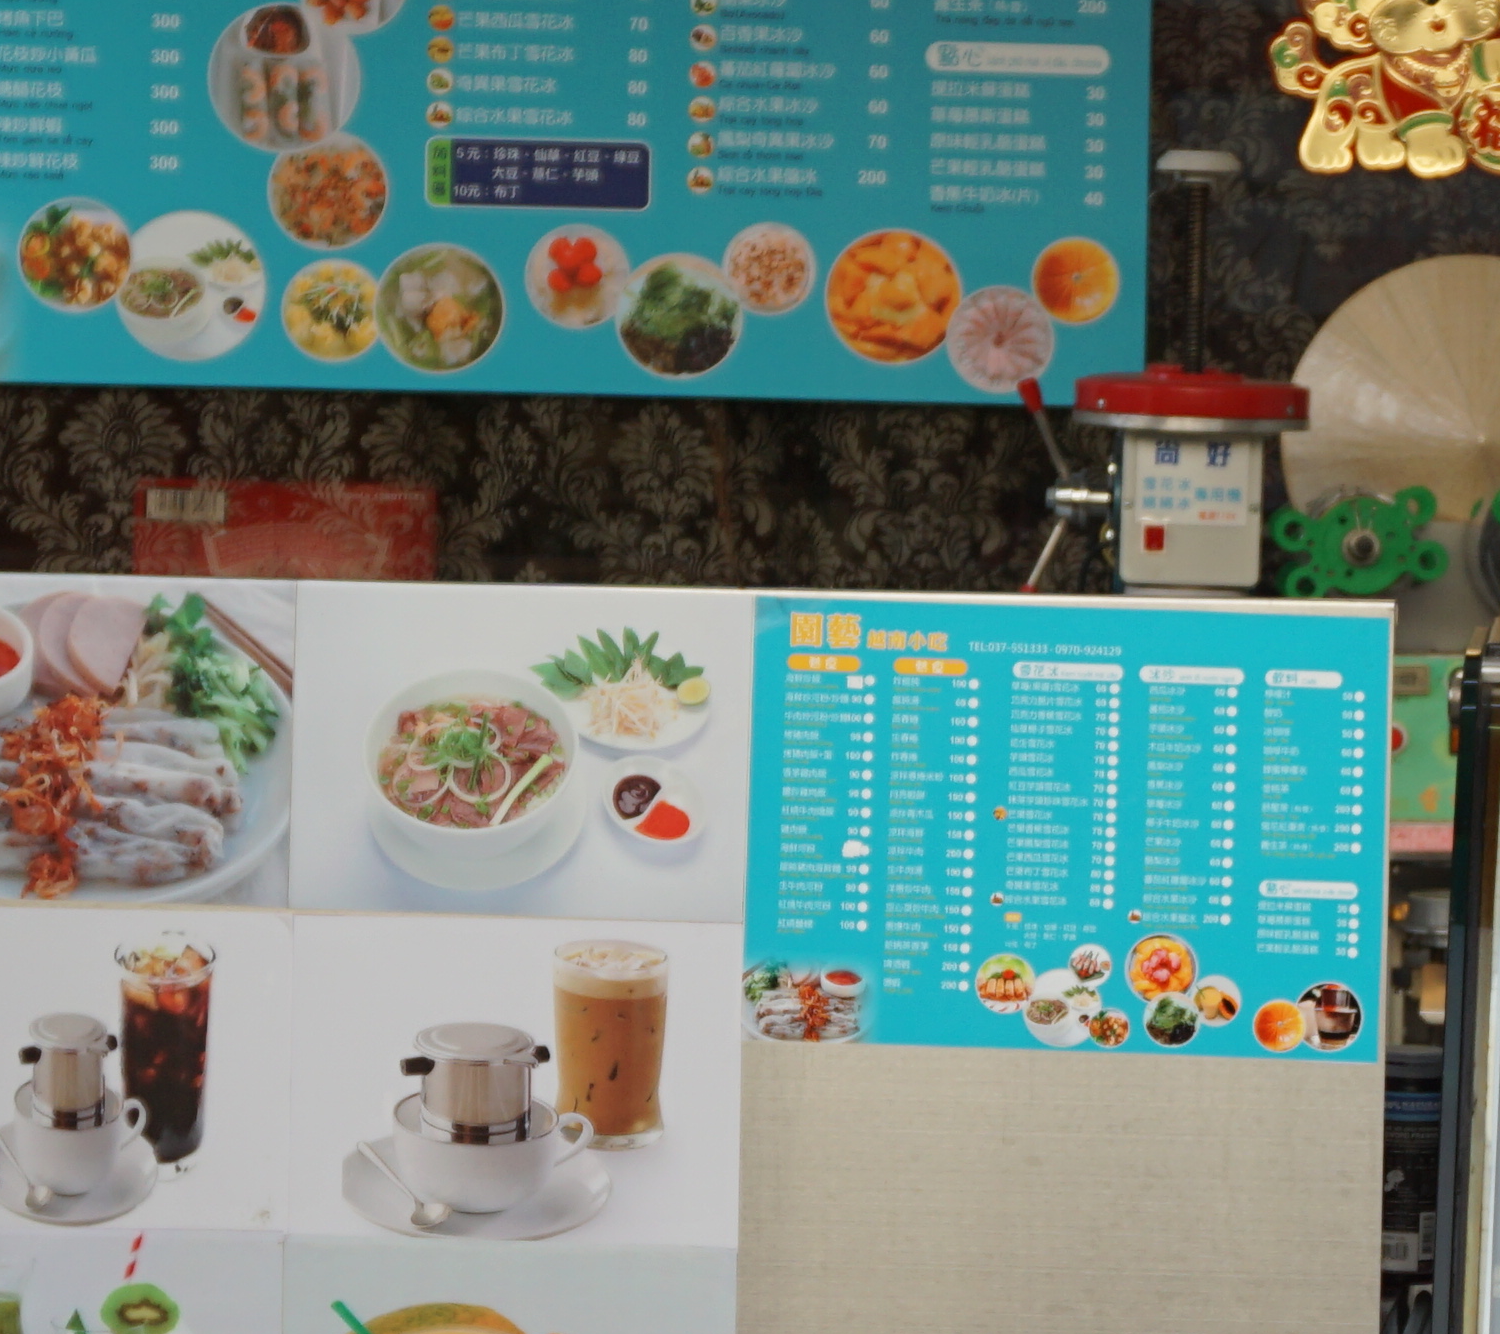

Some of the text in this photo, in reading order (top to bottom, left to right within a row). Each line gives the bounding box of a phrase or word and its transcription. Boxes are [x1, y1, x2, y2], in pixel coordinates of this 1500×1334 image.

[152, 84, 180, 100] 300
[151, 120, 180, 135] 300
[151, 155, 180, 171] 300
